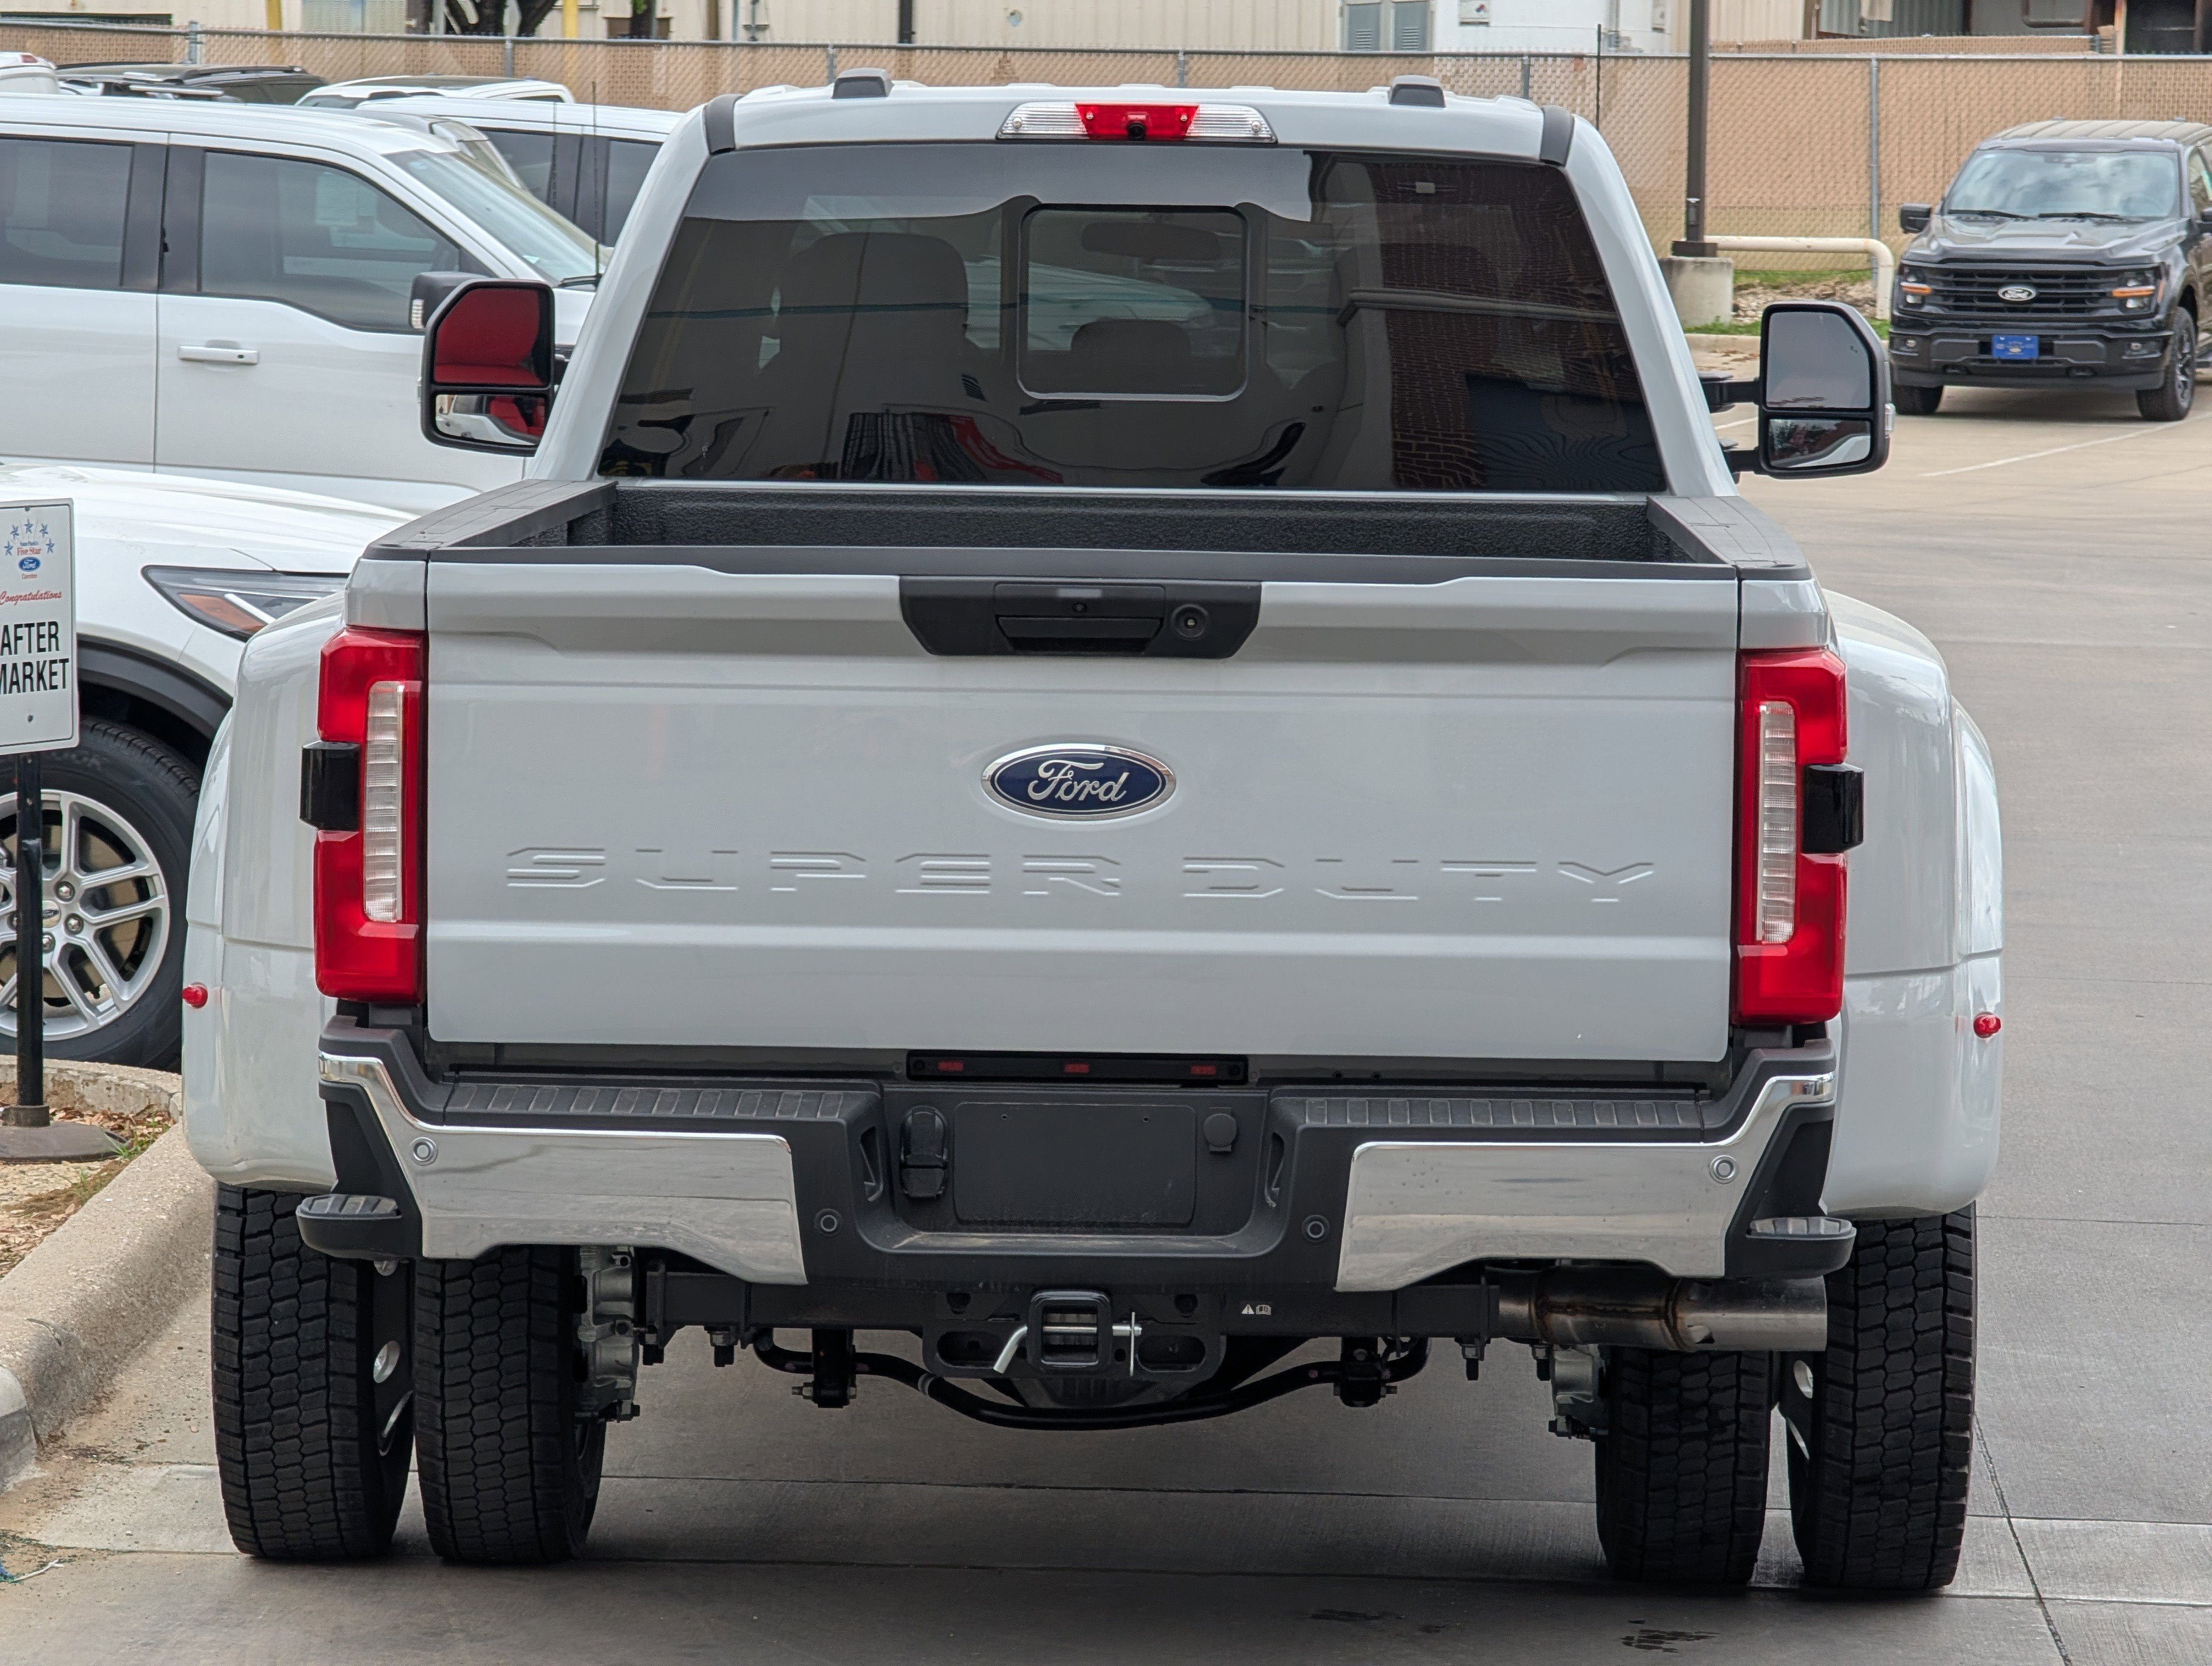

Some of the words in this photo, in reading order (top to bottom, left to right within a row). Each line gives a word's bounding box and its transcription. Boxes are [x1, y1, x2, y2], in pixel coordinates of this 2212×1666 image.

[0, 590, 62, 605] Congratulations
[0, 620, 60, 656] AFTER
[1027, 760, 1130, 802] Ford
[506, 847, 1121, 896] SUPER
[1182, 856, 1654, 902] DUTY
